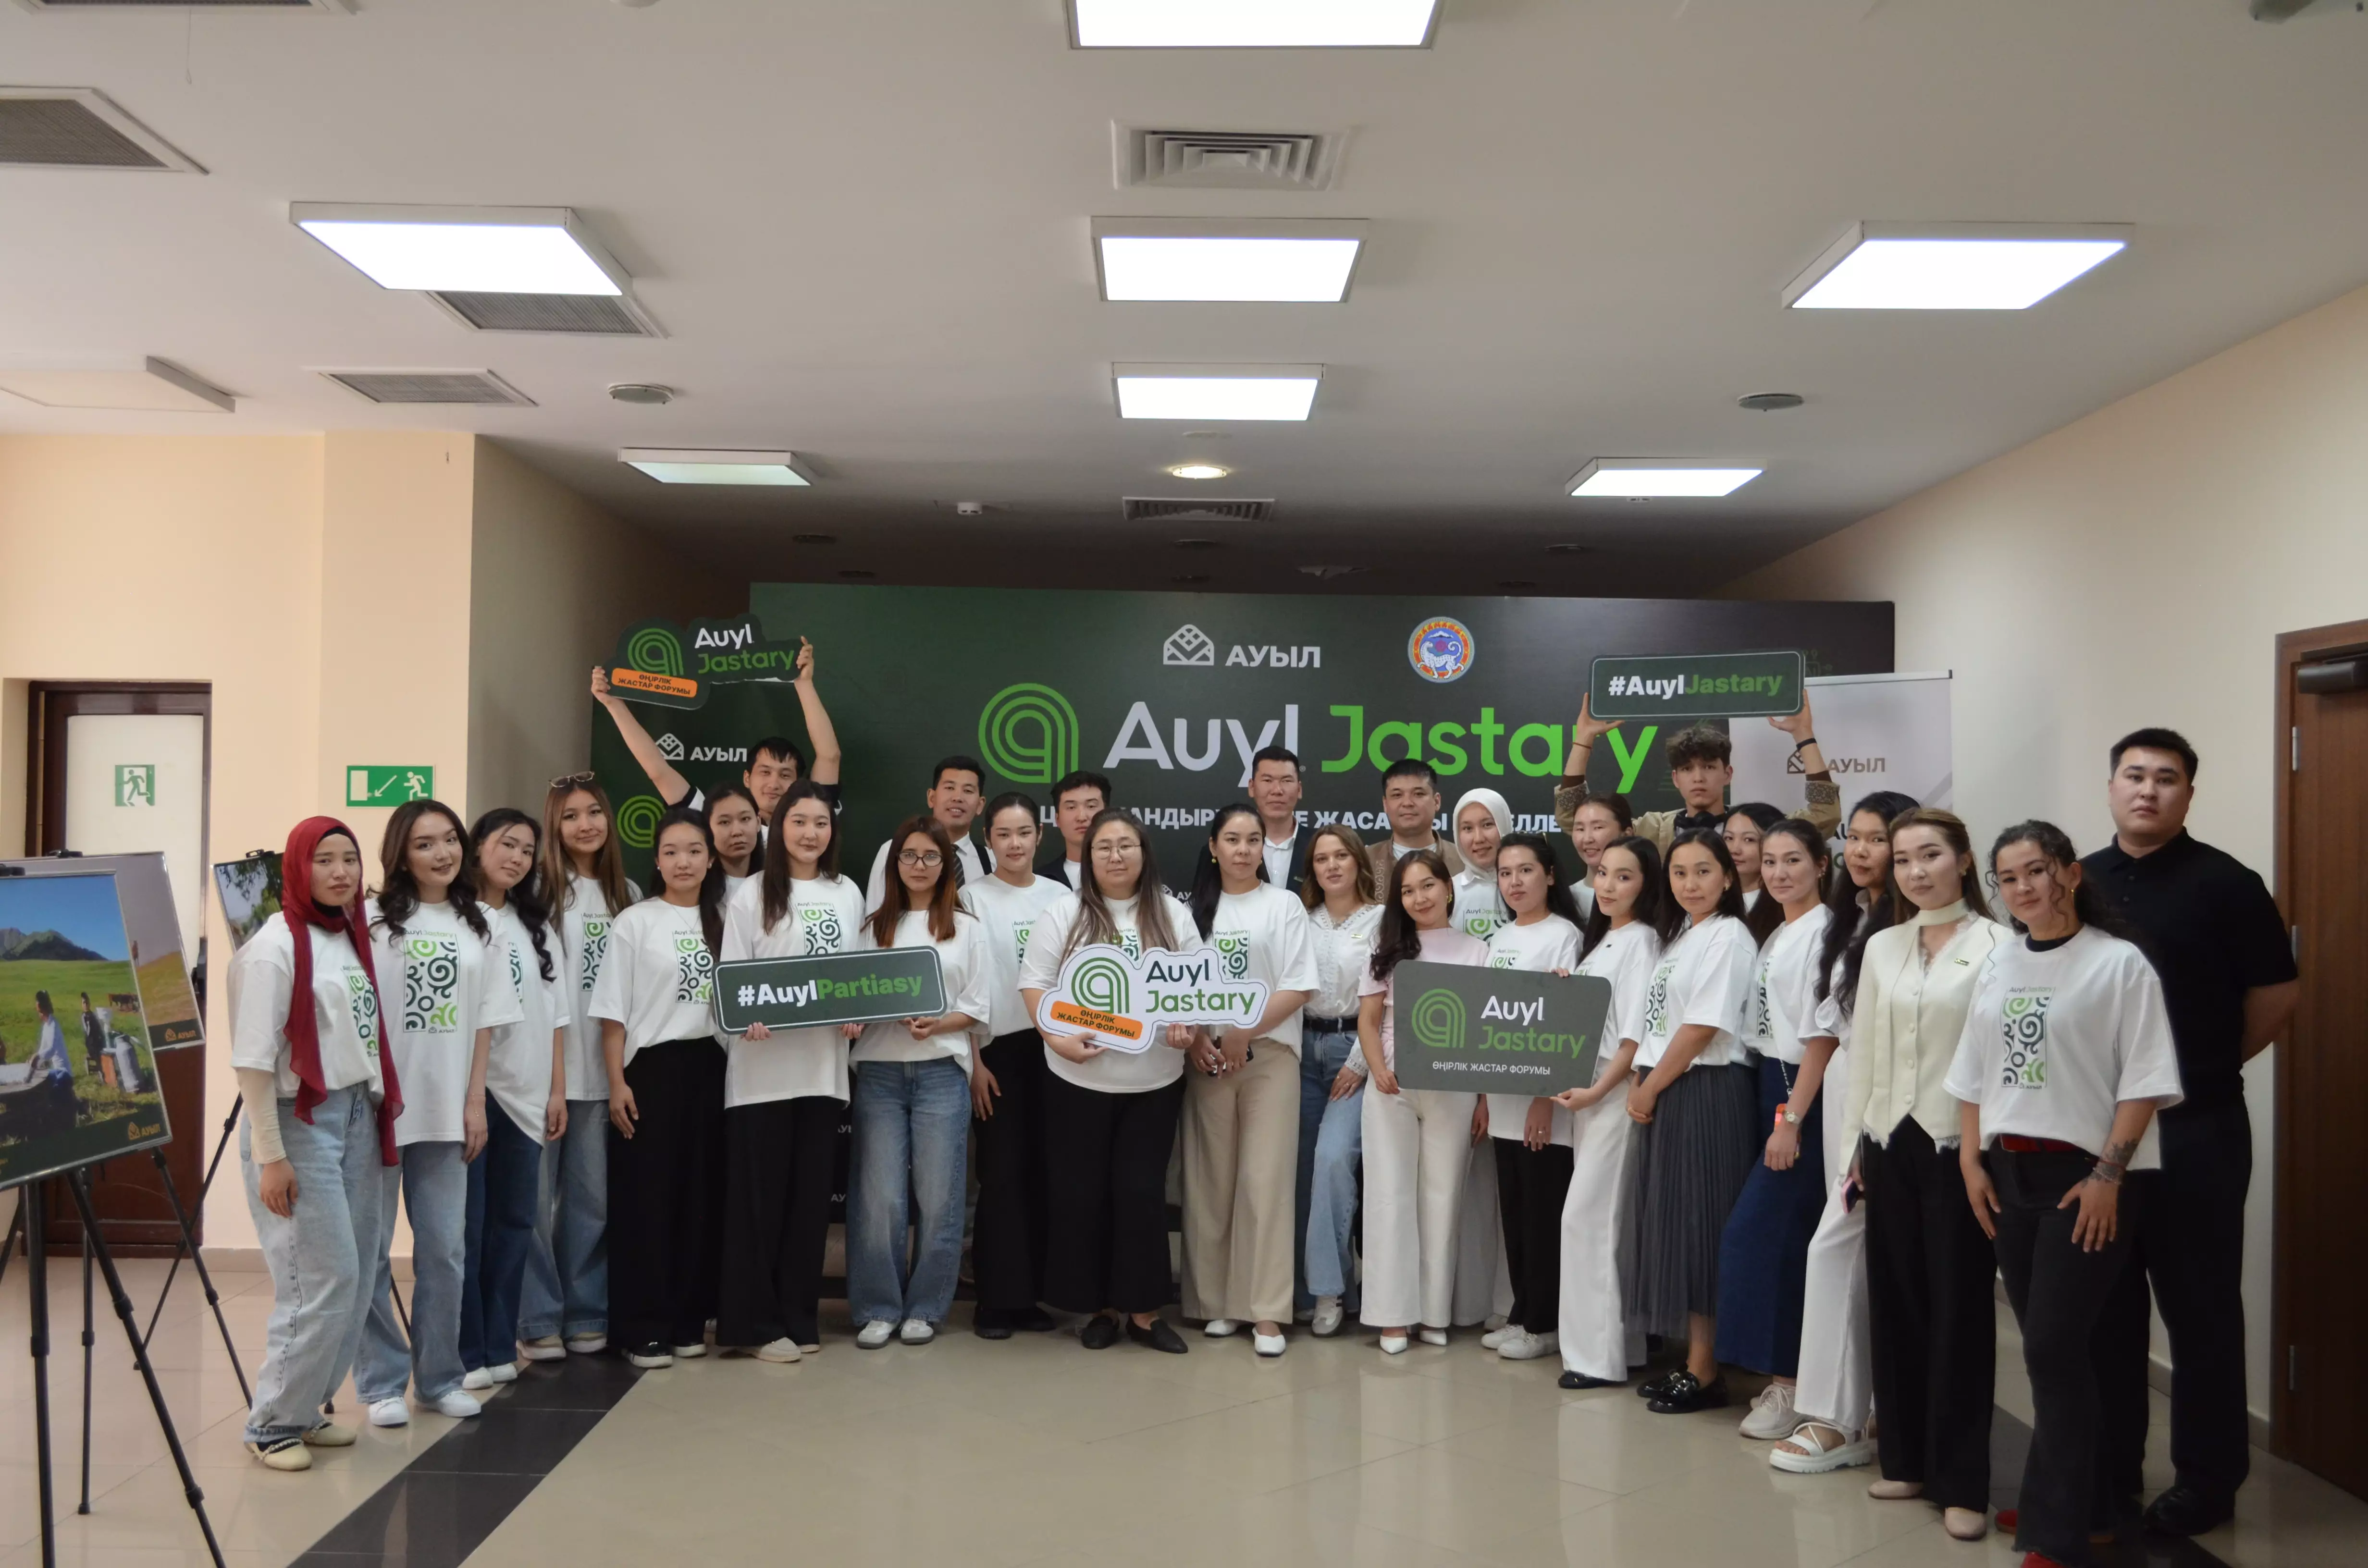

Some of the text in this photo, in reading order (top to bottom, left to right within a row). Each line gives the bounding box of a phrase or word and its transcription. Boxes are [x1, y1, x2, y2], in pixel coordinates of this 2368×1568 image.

[695, 624, 752, 649] Auyl
[698, 650, 794, 674] Jastary
[1226, 645, 1320, 668] АУЫЛ
[618, 678, 691, 695] ЖАСТАР ФОРУМЫ
[639, 674, 671, 685] ӨҢІРЛІК
[1608, 674, 1782, 699] #AuylJastary
[690, 747, 747, 762] АУЫЛ
[1103, 701, 1658, 794] Auyl Jastay
[1827, 758, 1885, 773] АУЫЛ
[1146, 959, 1209, 987] Auyl
[738, 973, 922, 1007] #AuylPartiasy
[1146, 989, 1256, 1015] Jastary
[1080, 1010, 1115, 1024] ӨҢІРЛІК
[1480, 995, 1544, 1026] Auyl
[1057, 1012, 1135, 1037] ЖАСТАР ФОРУМЫ
[1478, 1025, 1586, 1059] Jastary
[1432, 1061, 1551, 1075] ӨҢІРЛІК ЖАСТАР ФОРУМЫ
